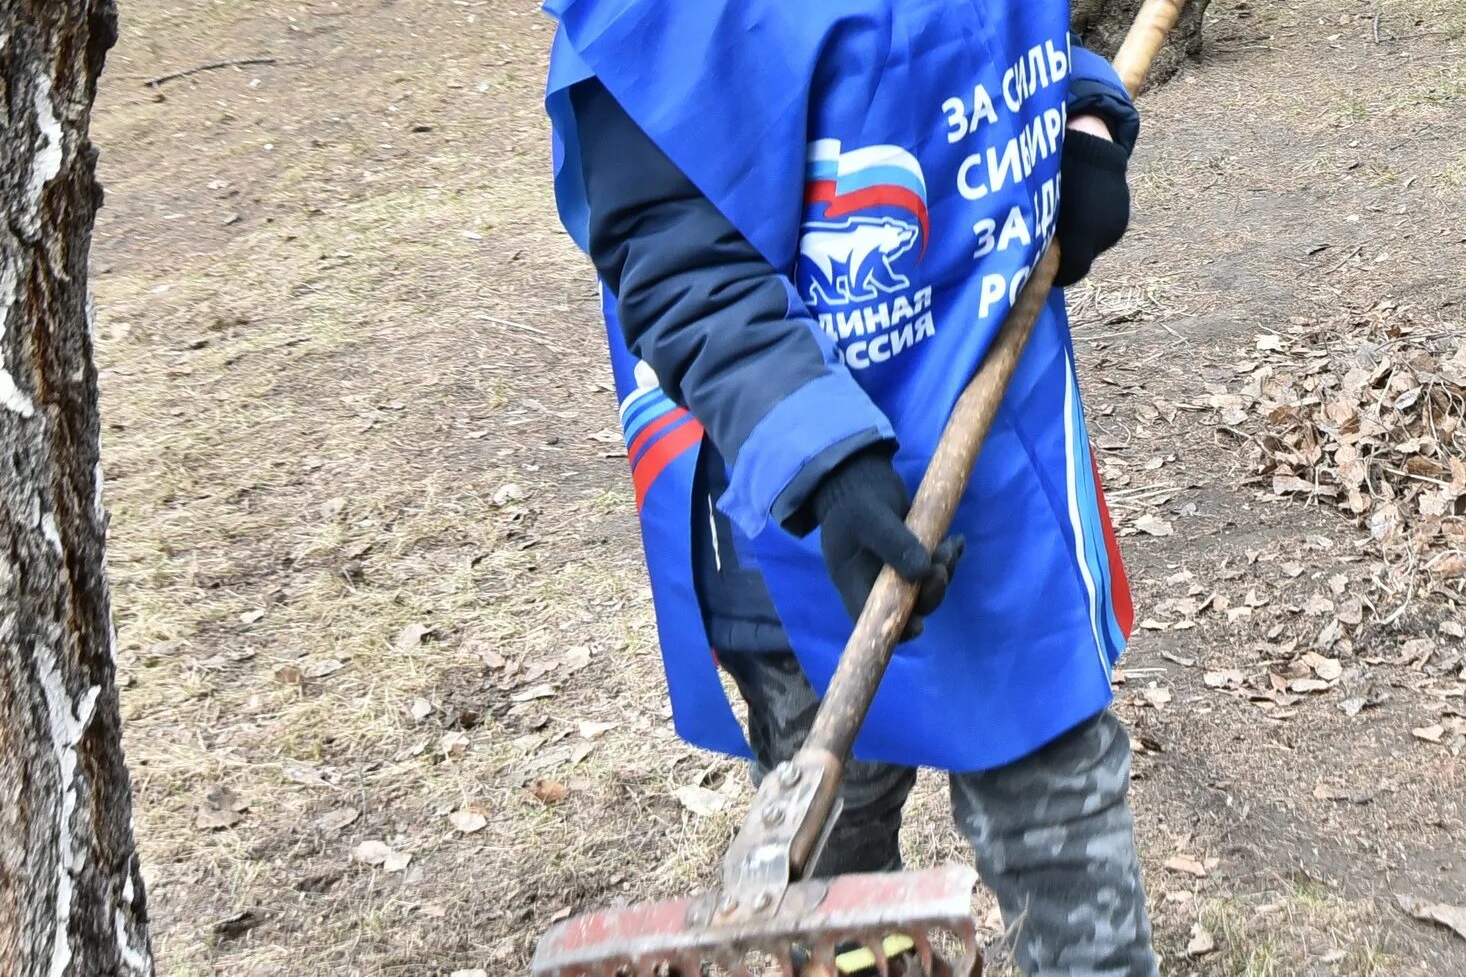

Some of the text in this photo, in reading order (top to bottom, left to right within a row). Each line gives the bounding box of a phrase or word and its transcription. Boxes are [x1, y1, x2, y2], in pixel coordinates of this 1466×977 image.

[941, 30, 1072, 144] ЗА СИЛЬ
[957, 100, 1067, 200] СИБИР
[972, 205, 1031, 260] ЗА
[818, 285, 932, 342] ДИНАЯ
[838, 310, 936, 370] ССИЯ
